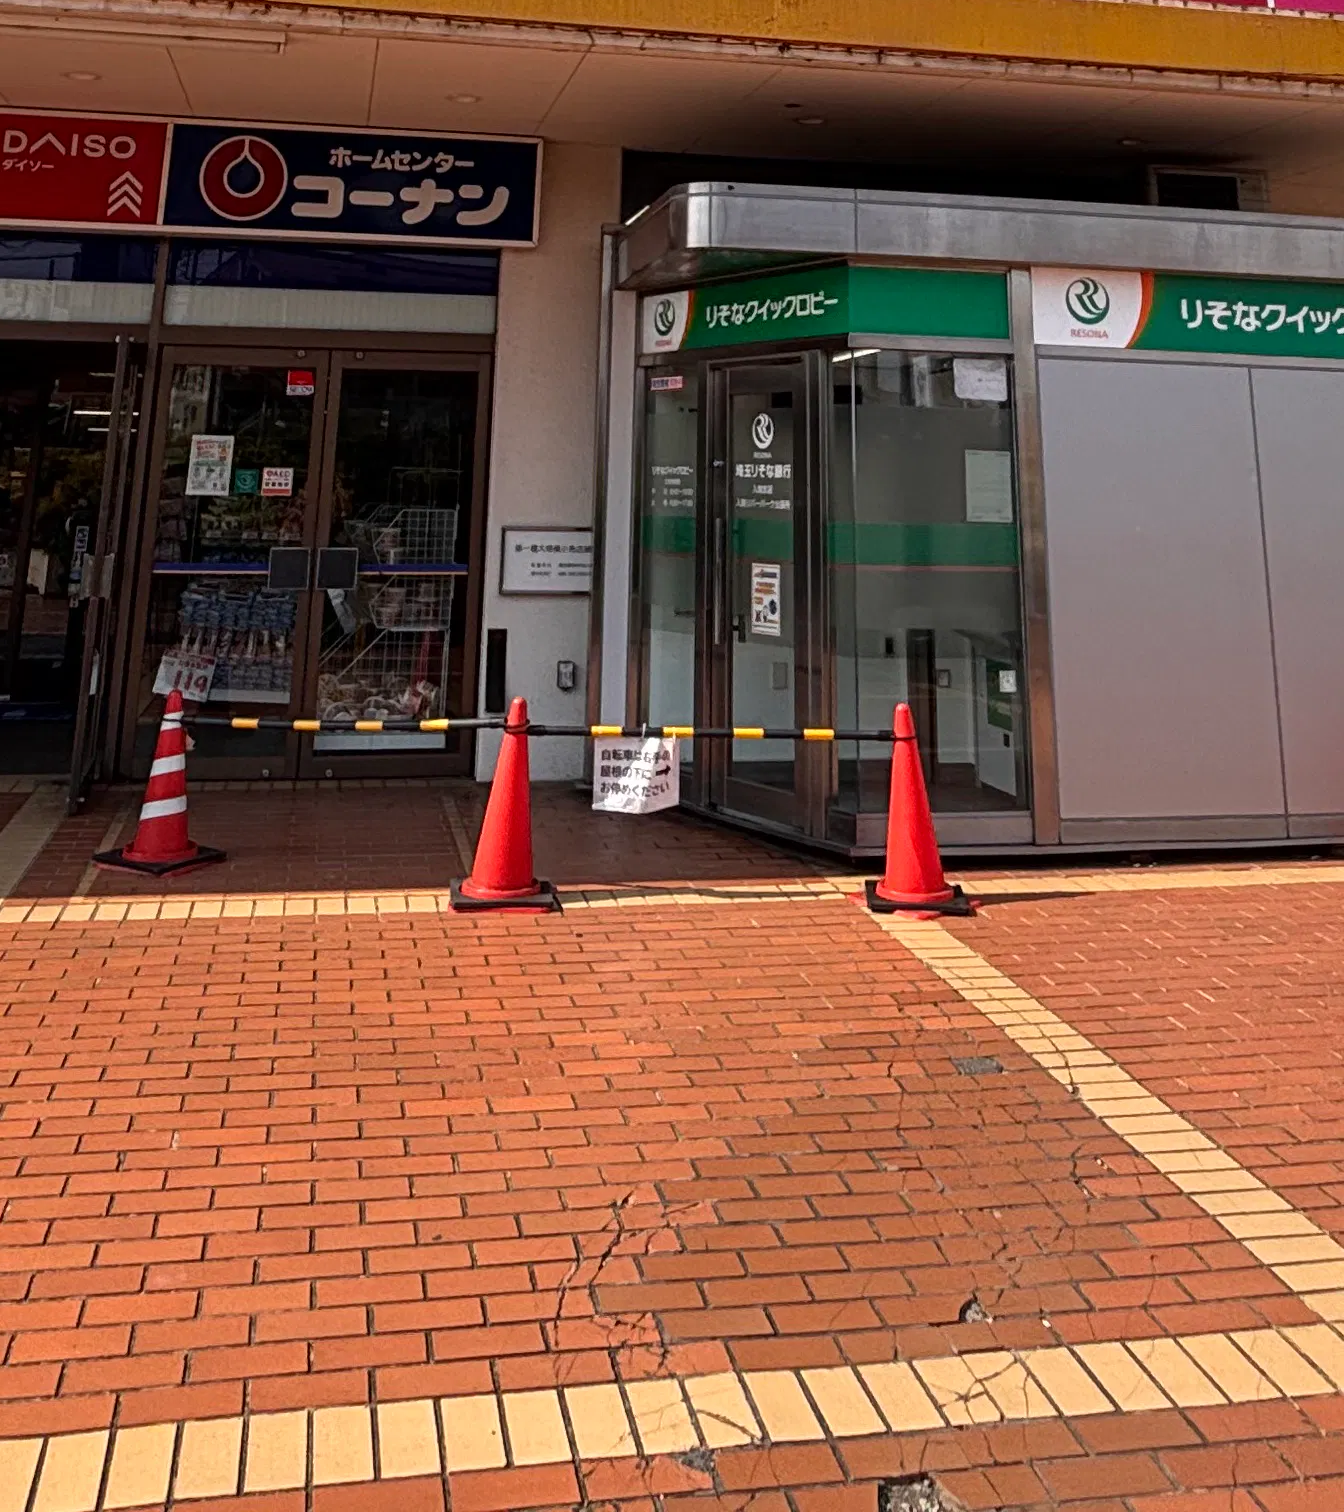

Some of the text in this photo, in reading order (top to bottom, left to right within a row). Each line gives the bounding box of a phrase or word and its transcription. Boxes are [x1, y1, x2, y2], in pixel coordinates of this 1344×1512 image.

[3, 130, 136, 160] DAISO
[329, 146, 475, 174] ホームセンター
[1, 159, 55, 172] ダイソー
[291, 175, 510, 227] コーナン
[706, 290, 839, 329] りそなクイックロビー
